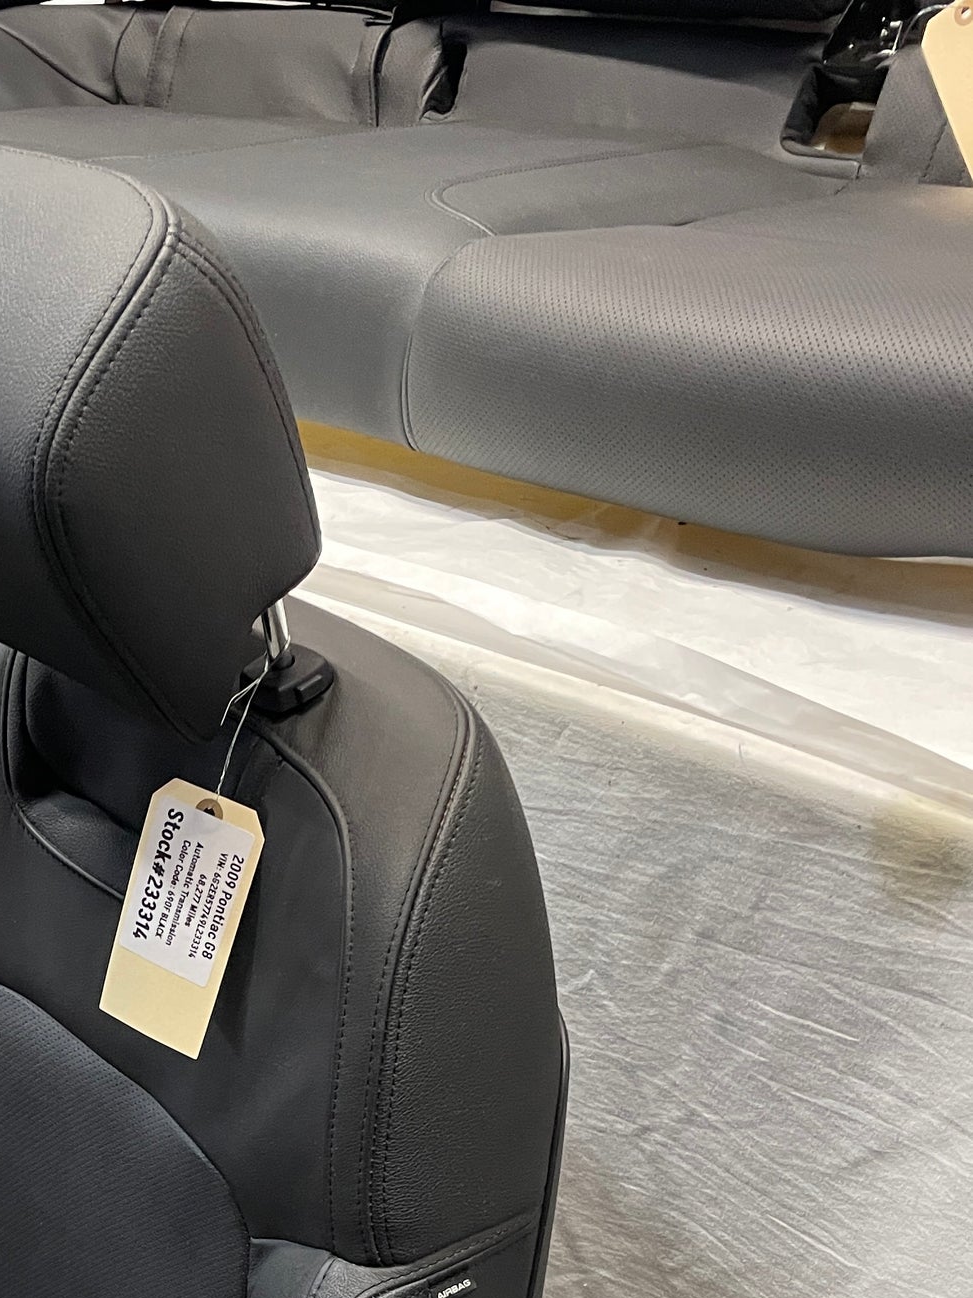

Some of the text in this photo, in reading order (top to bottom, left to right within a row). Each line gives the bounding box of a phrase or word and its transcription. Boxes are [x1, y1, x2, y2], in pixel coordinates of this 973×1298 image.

[179, 840, 191, 863] Color
[217, 853, 228, 872] VIN:
[132, 808, 184, 940] Stock#233314
[165, 842, 204, 946] Automatic Transmission
[170, 863, 184, 891] Code:
[185, 874, 208, 927] 68,277 Miles
[202, 854, 244, 960] 2009 Pontiac G8
[155, 911, 169, 938] BLACK
